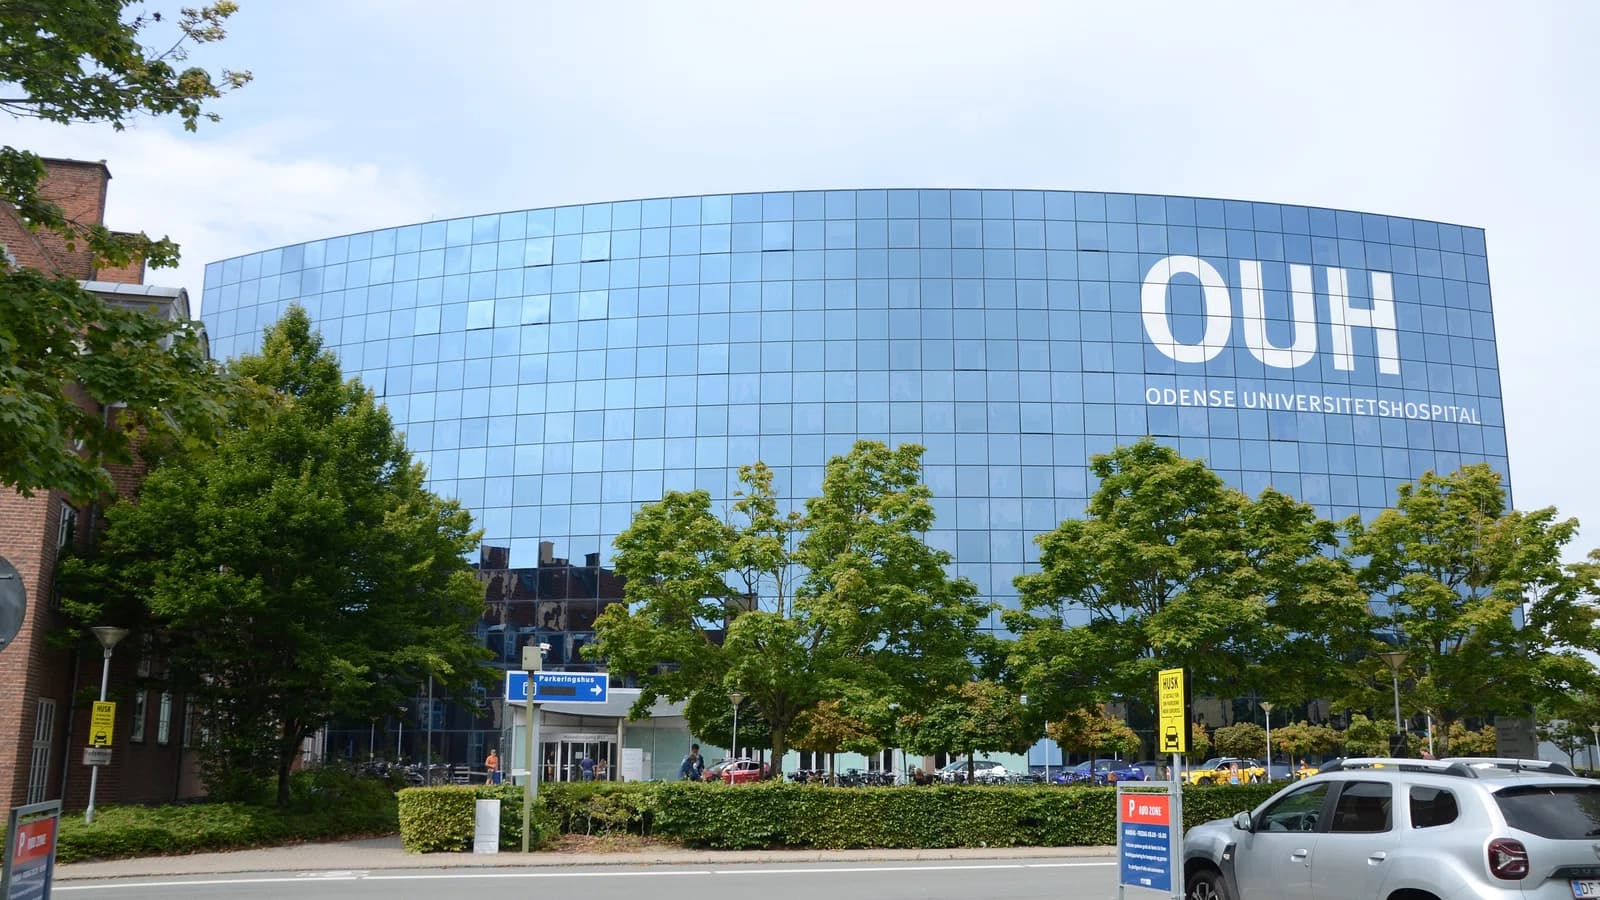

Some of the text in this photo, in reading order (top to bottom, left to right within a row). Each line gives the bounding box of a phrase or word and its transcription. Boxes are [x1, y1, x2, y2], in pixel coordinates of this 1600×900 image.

[1141, 255, 1400, 375] OUH
[1145, 387, 1481, 425] ODENSE UNIVERSITETSHOSPITAL
[539, 675, 595, 683] Parkeringshus
[1163, 676, 1179, 689] HUSK
[1128, 799, 1136, 817] P
